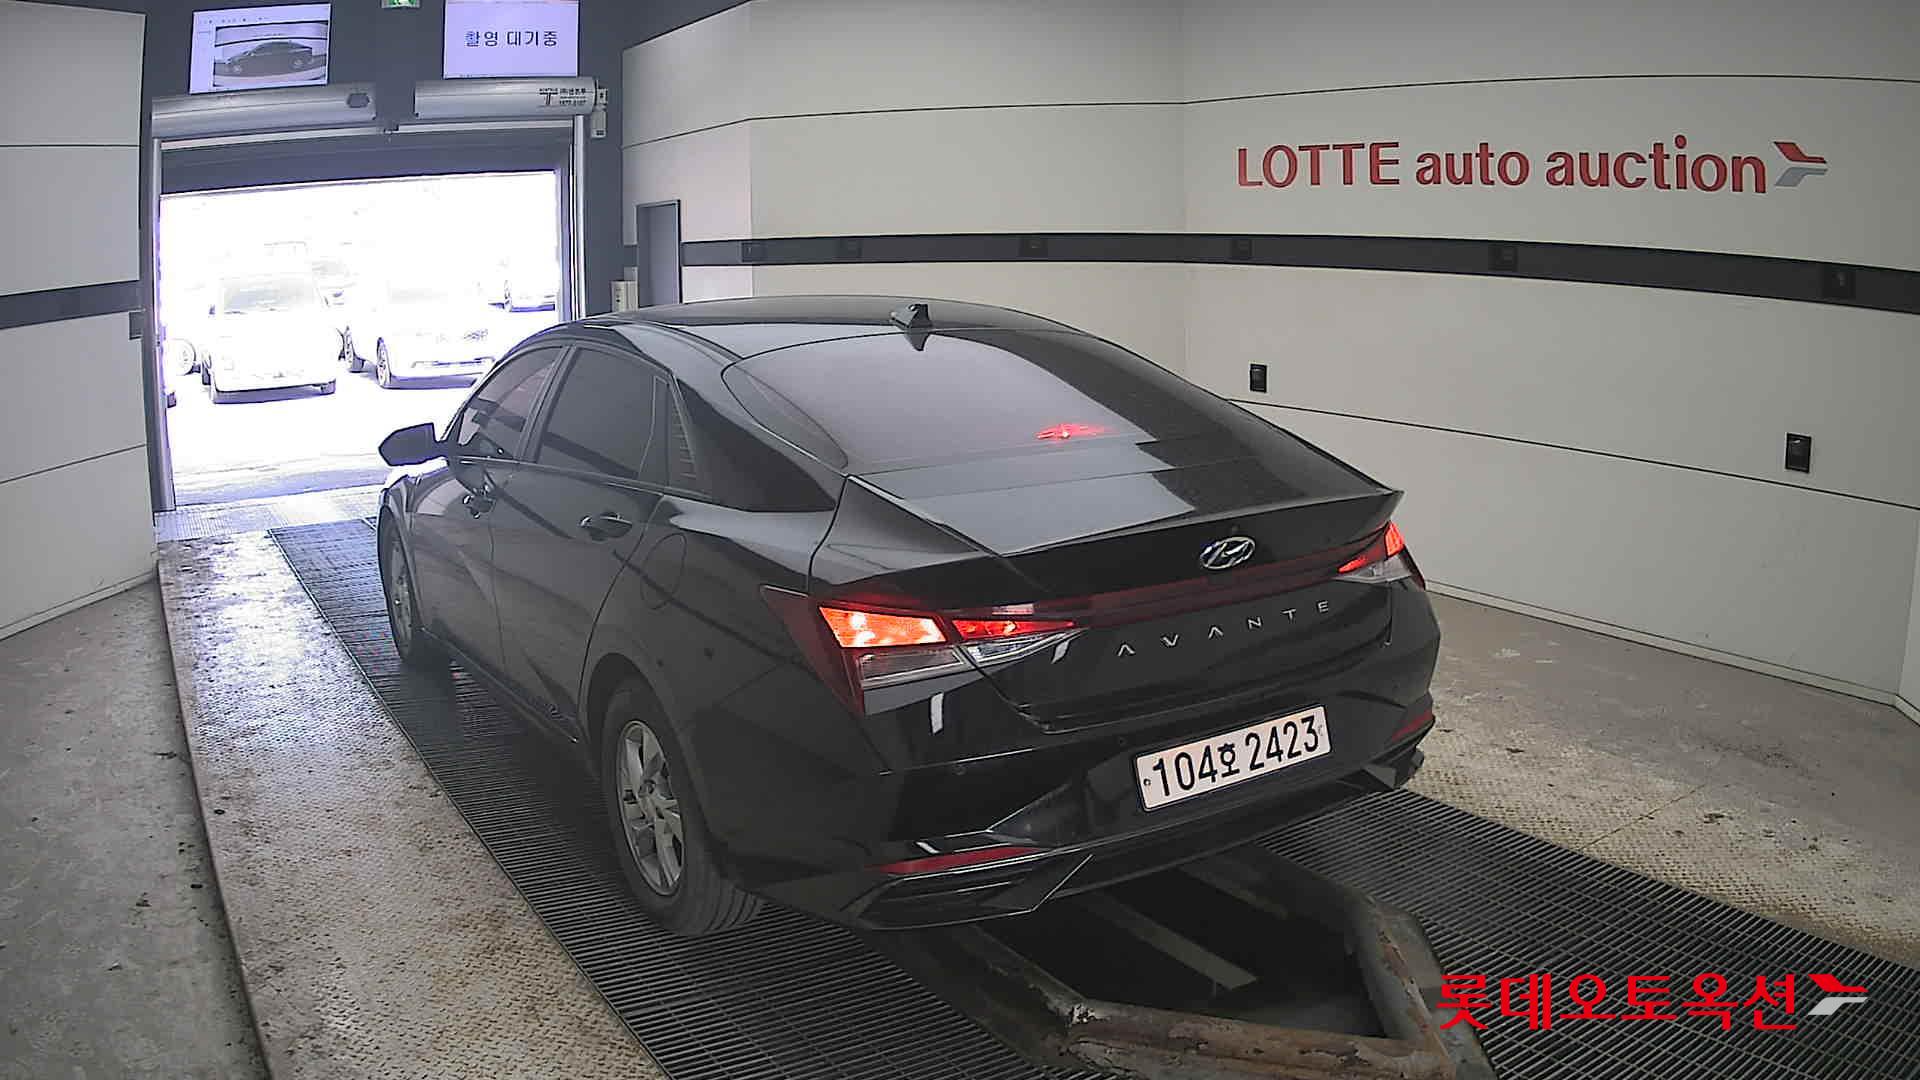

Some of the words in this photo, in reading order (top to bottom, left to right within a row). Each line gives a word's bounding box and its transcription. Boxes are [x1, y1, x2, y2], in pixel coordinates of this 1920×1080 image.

[506, 31, 558, 47] 대기중
[1237, 141, 1400, 188] LOTTE
[1415, 142, 1530, 186] auto
[1545, 134, 1767, 193] auction
[1117, 600, 1329, 657] AVANTE
[1245, 715, 1319, 771] 2423
